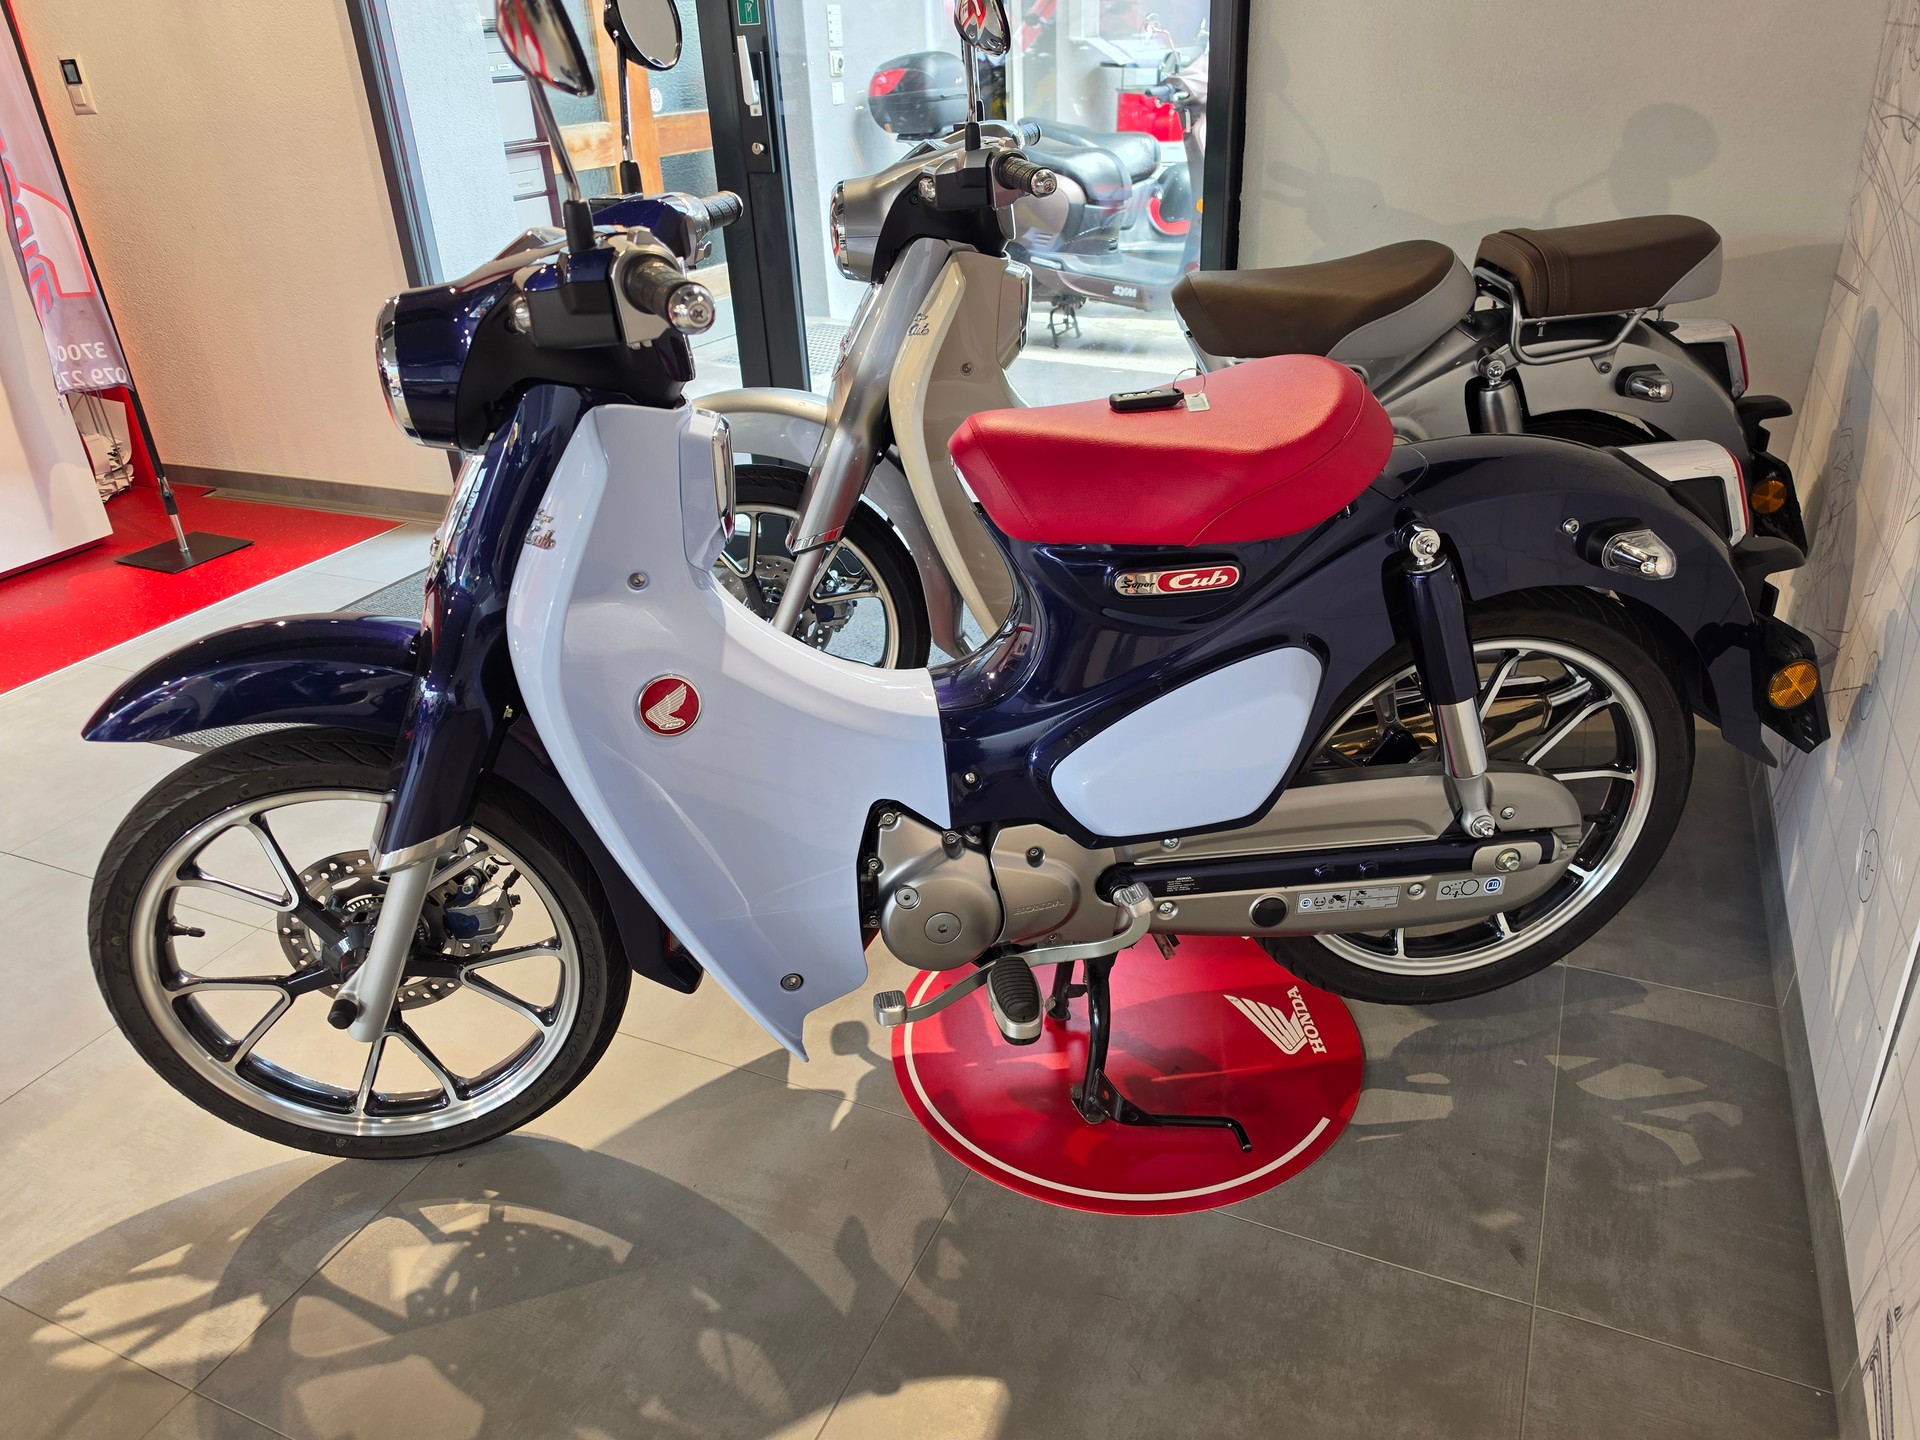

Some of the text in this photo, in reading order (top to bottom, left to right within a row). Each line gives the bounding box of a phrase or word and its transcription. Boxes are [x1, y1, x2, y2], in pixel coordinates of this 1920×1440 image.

[1112, 285, 1137, 298] SYM
[1120, 570, 1228, 590] Super Cub
[1013, 900, 1065, 916] HONDA
[1286, 984, 1328, 1055] HONDA
